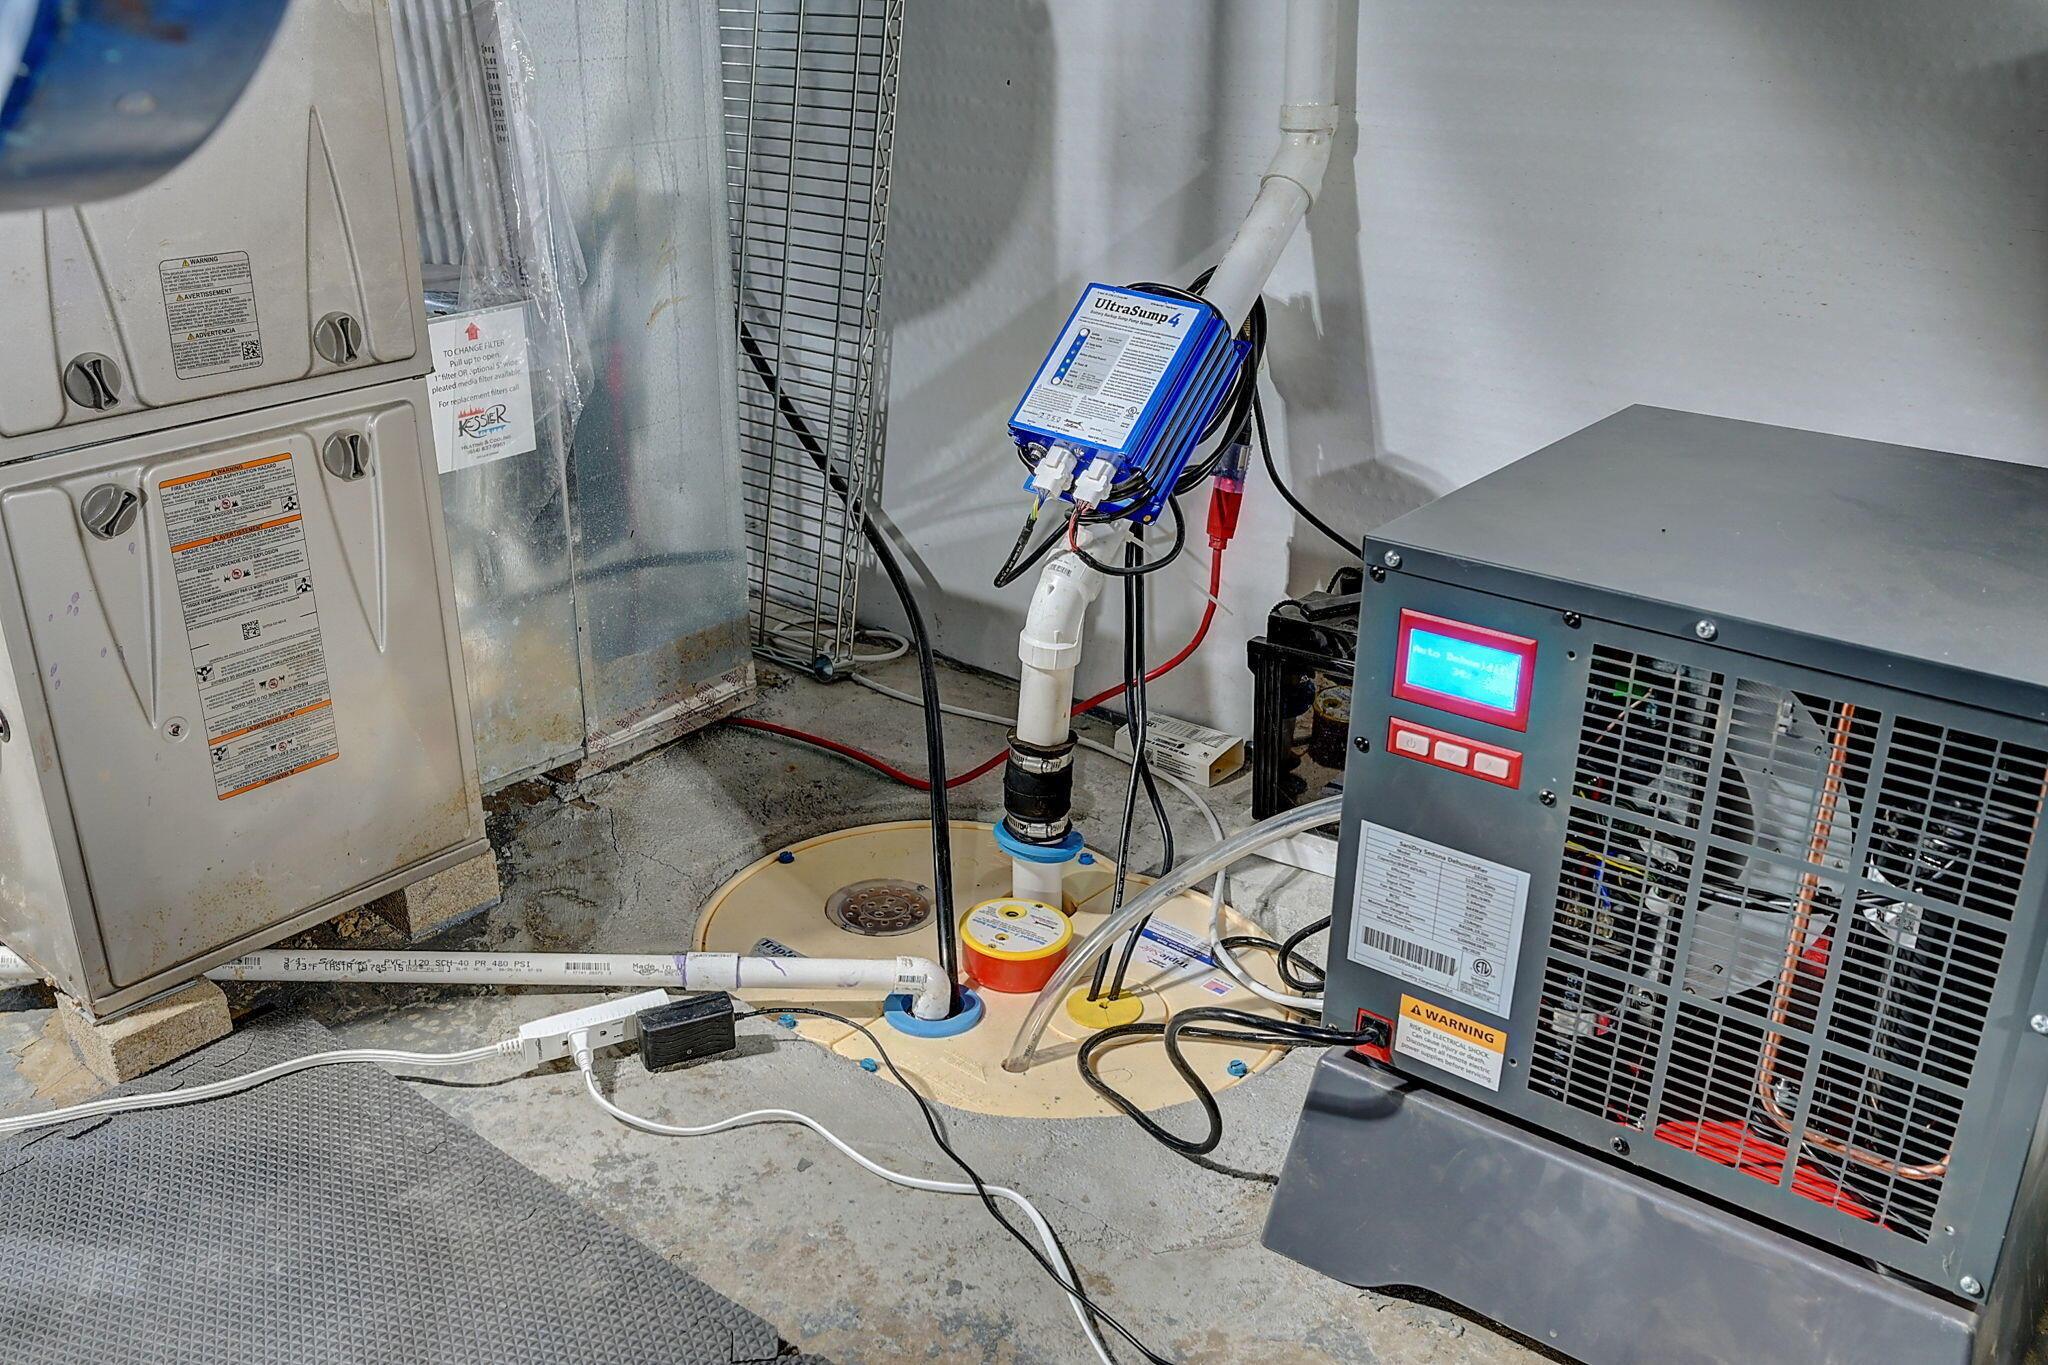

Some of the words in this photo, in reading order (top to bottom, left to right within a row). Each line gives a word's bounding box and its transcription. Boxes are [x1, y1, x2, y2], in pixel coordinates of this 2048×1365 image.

[190, 256, 218, 264] WARNING
[184, 288, 232, 299] AVERTISSEMENT
[195, 327, 235, 338] ADVERTENCIA
[443, 349, 452, 357] TO
[454, 343, 482, 355] CHANGE
[450, 358, 462, 367] Pull
[463, 357, 472, 366] up
[441, 371, 456, 380] filter
[457, 369, 467, 377] OR
[431, 381, 457, 394] pleated
[478, 374, 492, 383] filter
[438, 400, 448, 408] For
[490, 386, 507, 396] filters
[384, 959, 430, 967] PVC-1120
[435, 959, 469, 967] SCH-40
[514, 960, 530, 968] PSI
[633, 962, 655, 970] Made
[1425, 1008, 1494, 1043] WARNING
[1409, 1022, 1421, 1032] RISK
[1432, 1031, 1466, 1049] ELECTRICAL
[1411, 1031, 1422, 1040] Can
[1423, 1036, 1439, 1046] cause
[1440, 1042, 1457, 1055] injury
[1401, 1042, 1419, 1054] power
[1420, 1049, 1444, 1064] supplies
[1444, 1059, 1464, 1071] before
[1406, 1035, 1436, 1052] Disconnect
[1446, 1052, 1467, 1065] remote
[1468, 1061, 1489, 1074] electric
